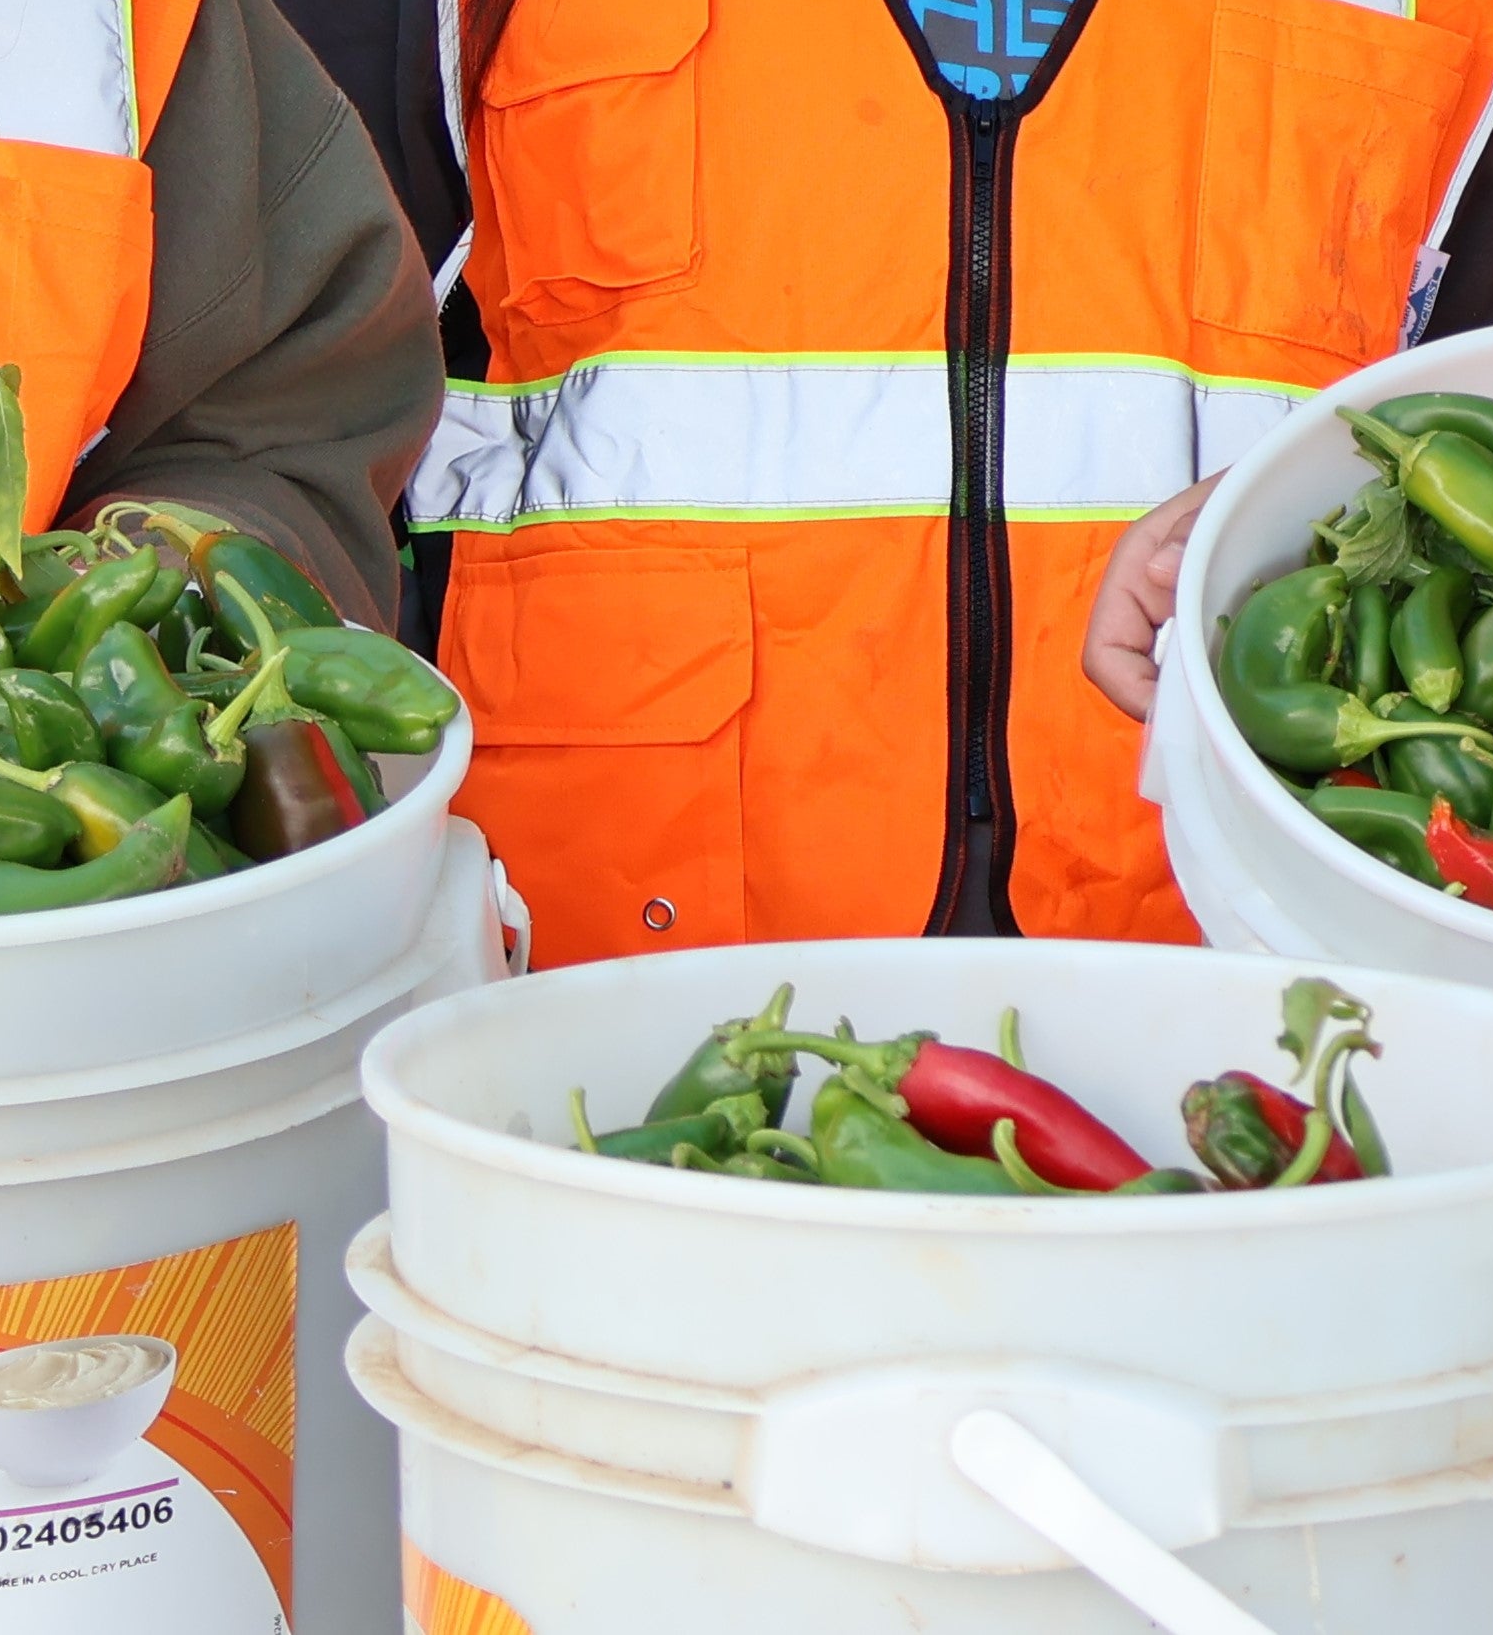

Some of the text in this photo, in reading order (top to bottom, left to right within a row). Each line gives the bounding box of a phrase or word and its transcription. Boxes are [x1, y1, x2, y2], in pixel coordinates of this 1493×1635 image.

[22, 1577, 34, 1585] IN
[37, 1574, 46, 1583] A
[91, 1563, 116, 1575] DRY
[119, 1552, 158, 1569] PLACE
